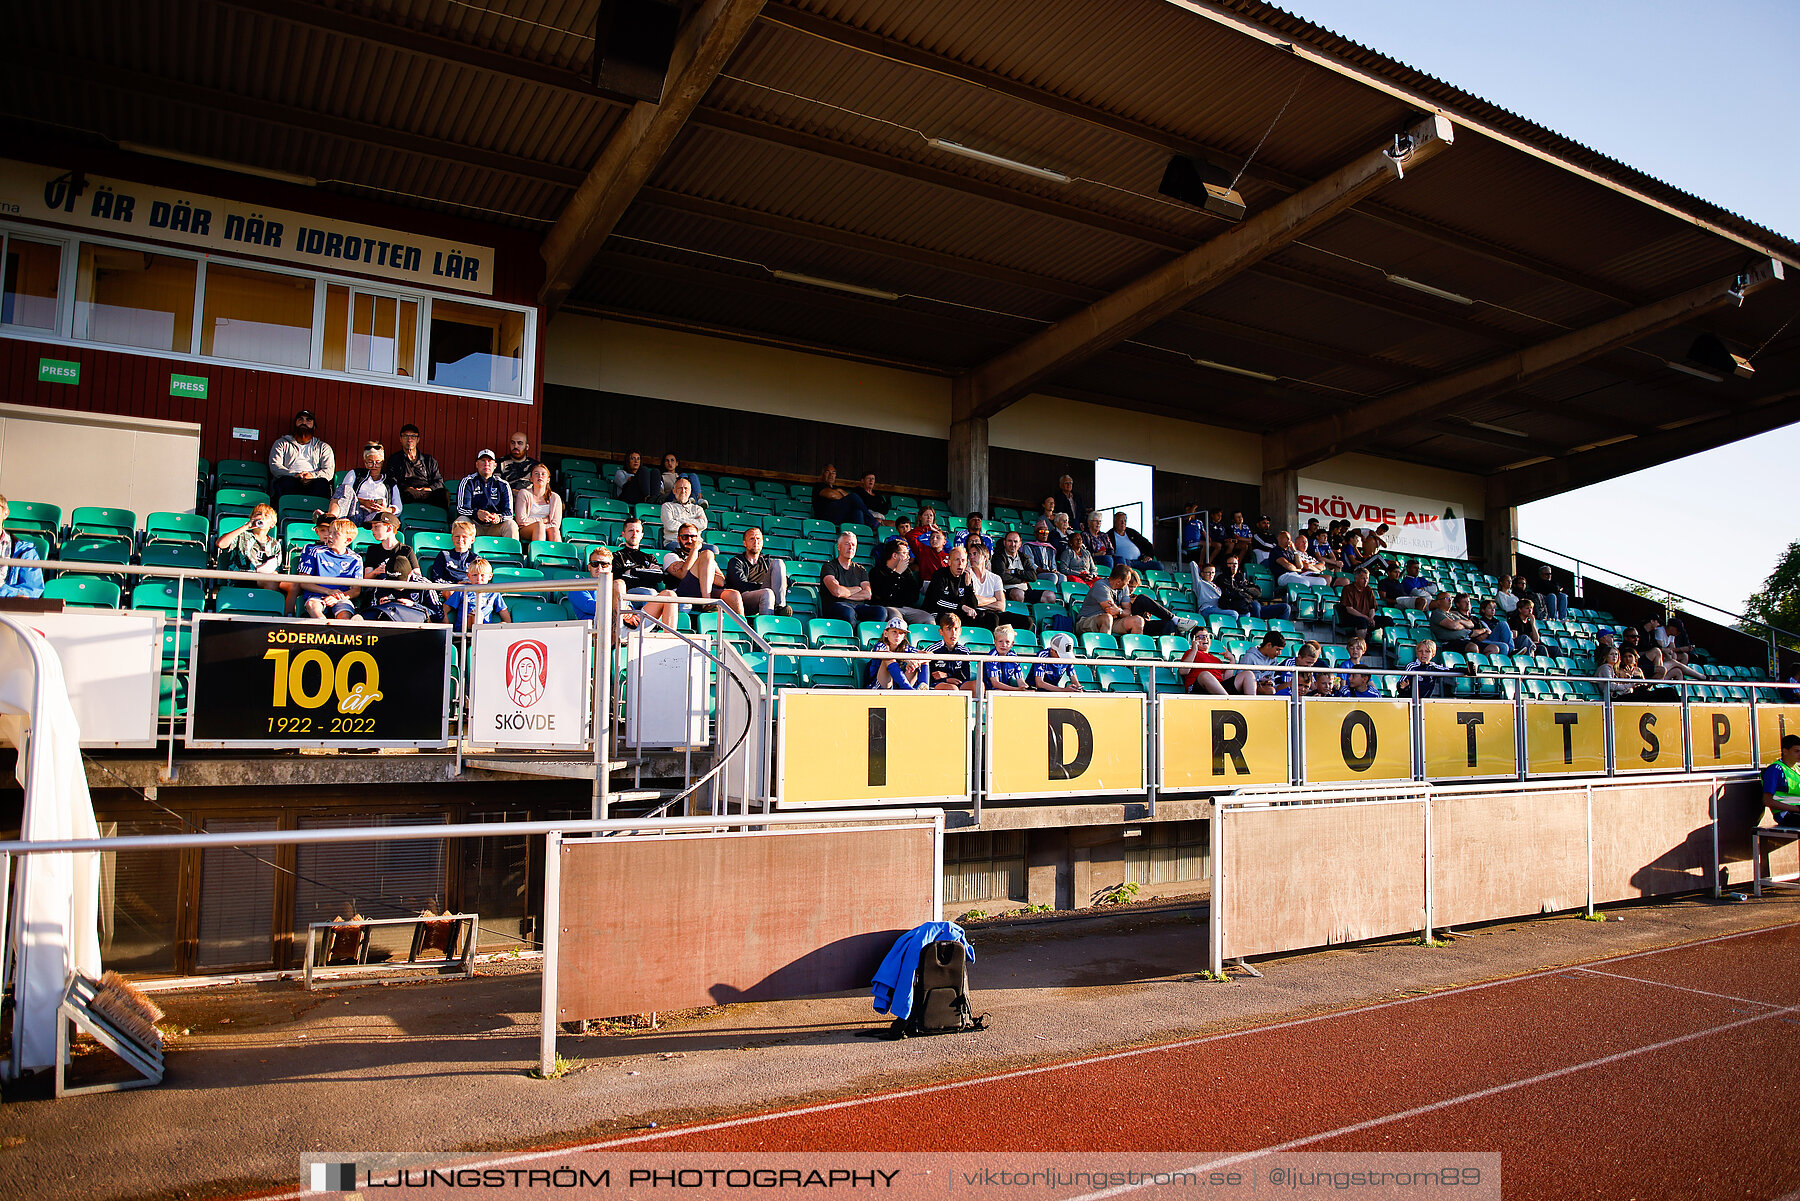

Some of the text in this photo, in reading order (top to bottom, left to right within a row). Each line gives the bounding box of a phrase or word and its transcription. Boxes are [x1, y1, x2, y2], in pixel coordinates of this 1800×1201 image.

[91, 185, 136, 222] ÄR
[149, 199, 212, 236] DÄR
[224, 212, 284, 248] NÄR
[296, 226, 422, 272] IDROTTEN
[432, 248, 480, 282] LÄR
[42, 365, 77, 377] PRESS
[172, 380, 205, 392] PRESS
[1298, 494, 1440, 532] SKÖVDE AIK
[267, 629, 379, 646] SÖDERMALMS IP
[263, 648, 380, 709] 100
[340, 685, 381, 711] år
[267, 717, 312, 733] 1922
[330, 717, 376, 733] 2022
[495, 710, 556, 731] SKÖVDE
